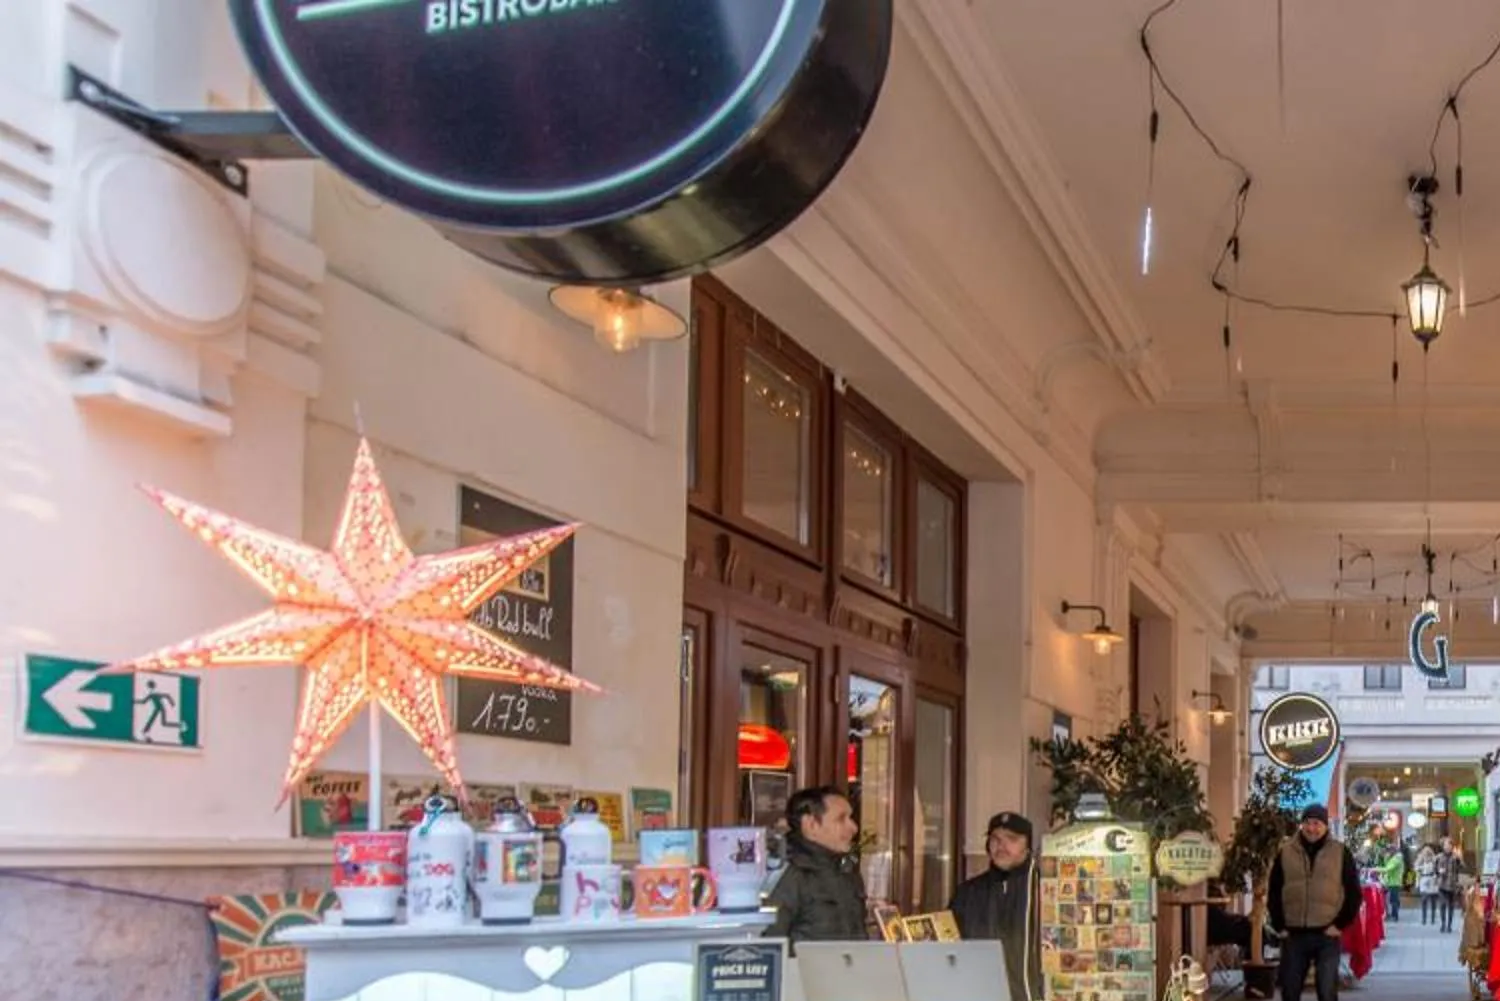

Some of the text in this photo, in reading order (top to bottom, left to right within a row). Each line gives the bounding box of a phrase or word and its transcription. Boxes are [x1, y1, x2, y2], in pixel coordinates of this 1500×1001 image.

[426, 0, 619, 33] BISTRO
[522, 607, 553, 641] bull
[1408, 611, 1449, 683] G
[712, 962, 769, 978] PRICE LIST
